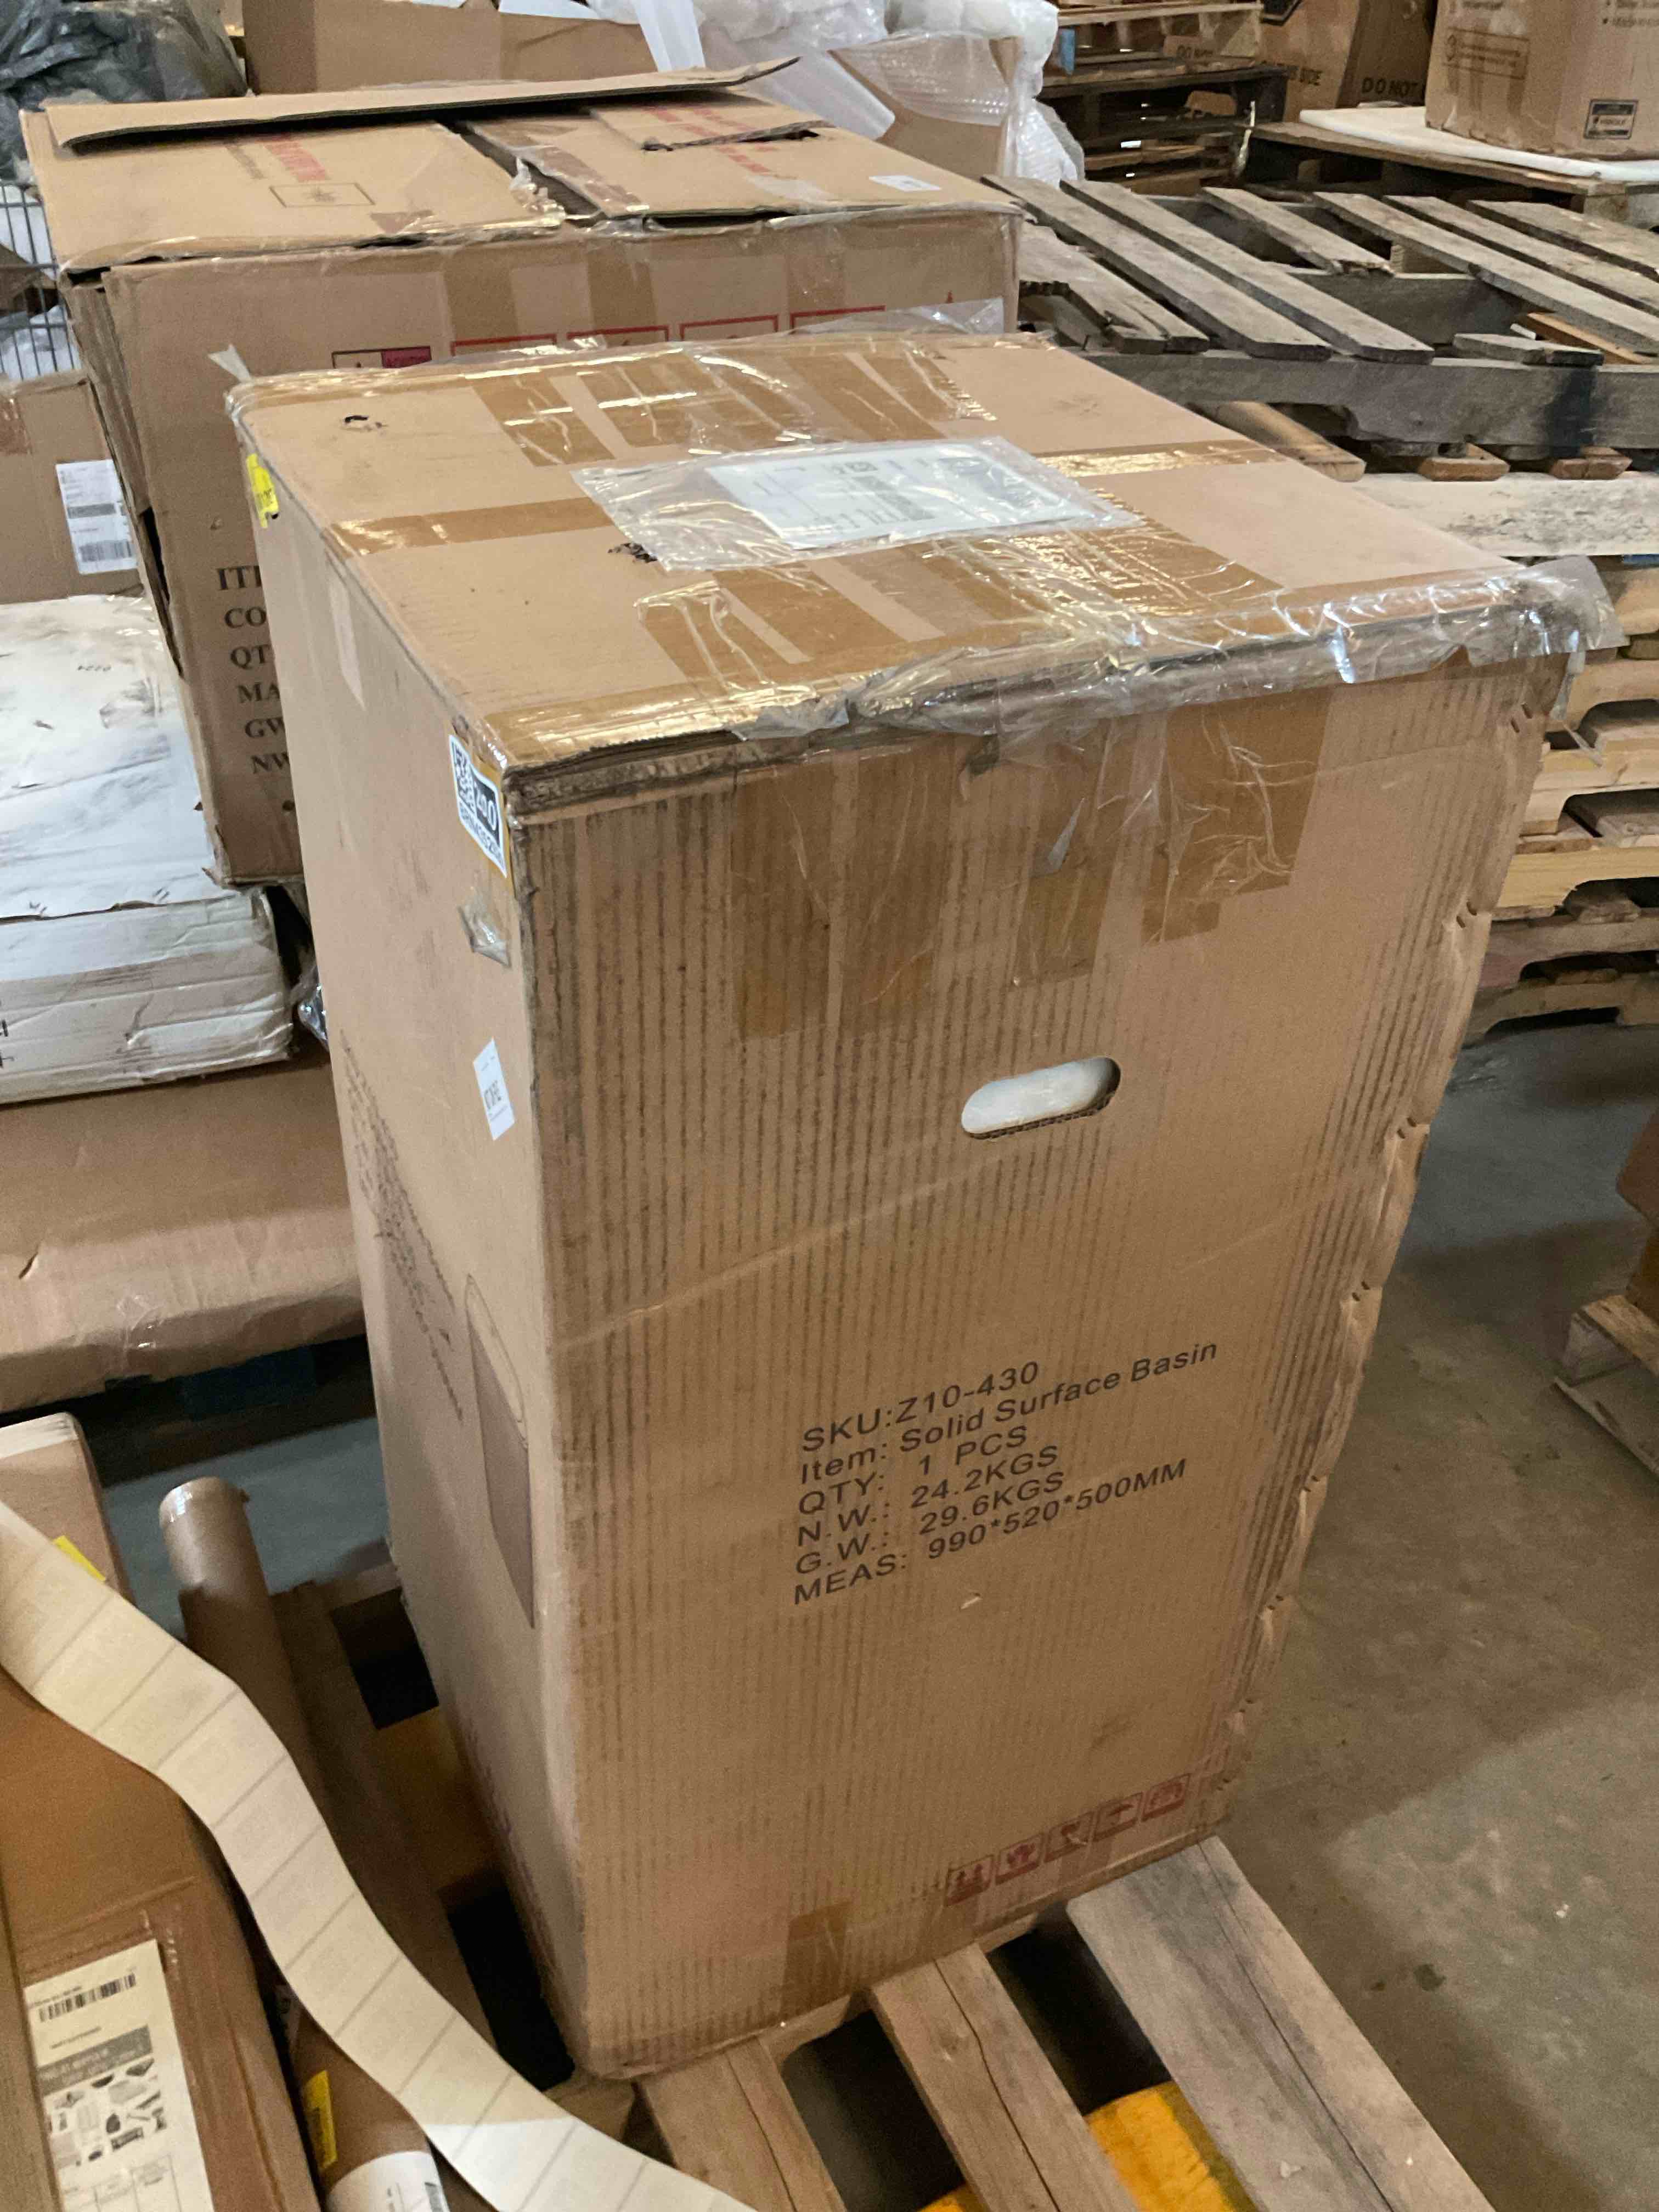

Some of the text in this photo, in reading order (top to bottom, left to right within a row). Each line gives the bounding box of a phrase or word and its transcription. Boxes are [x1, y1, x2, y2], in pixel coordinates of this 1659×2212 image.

[217, 565, 262, 591] IT
[802, 1342, 1217, 1484] Item: Solid Surface Basin
[799, 1425, 1027, 1516] QTY: 1 PCS
[910, 1444, 1058, 1509] 24.2KGS
[919, 1471, 1064, 1535] 29.6KGS
[793, 1553, 907, 1605] MEAS:
